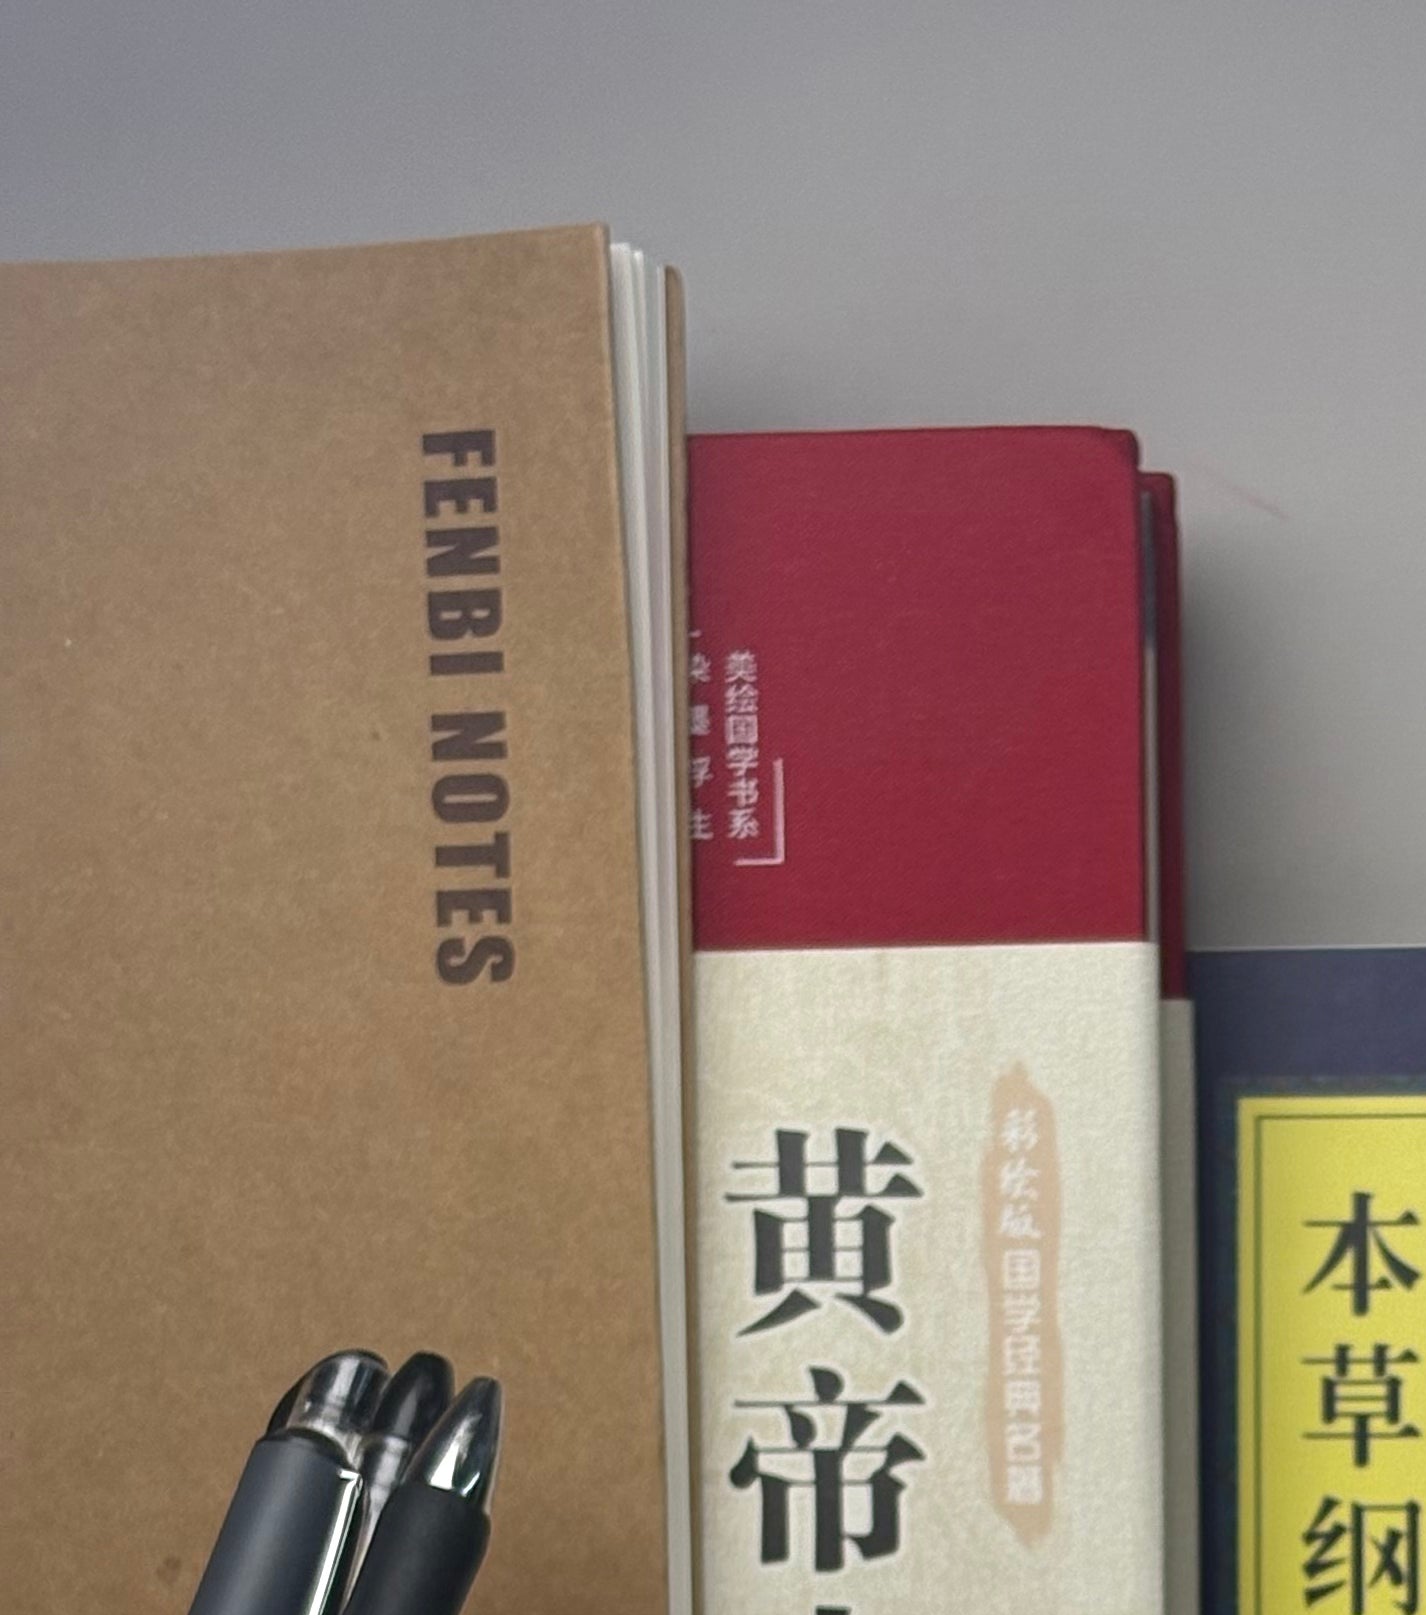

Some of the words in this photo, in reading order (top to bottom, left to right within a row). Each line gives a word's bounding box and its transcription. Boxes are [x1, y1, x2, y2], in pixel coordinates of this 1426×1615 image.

[421, 428, 504, 677] FENBI
[431, 711, 516, 986] NOTES
[724, 650, 759, 839] 美绘国学书系
